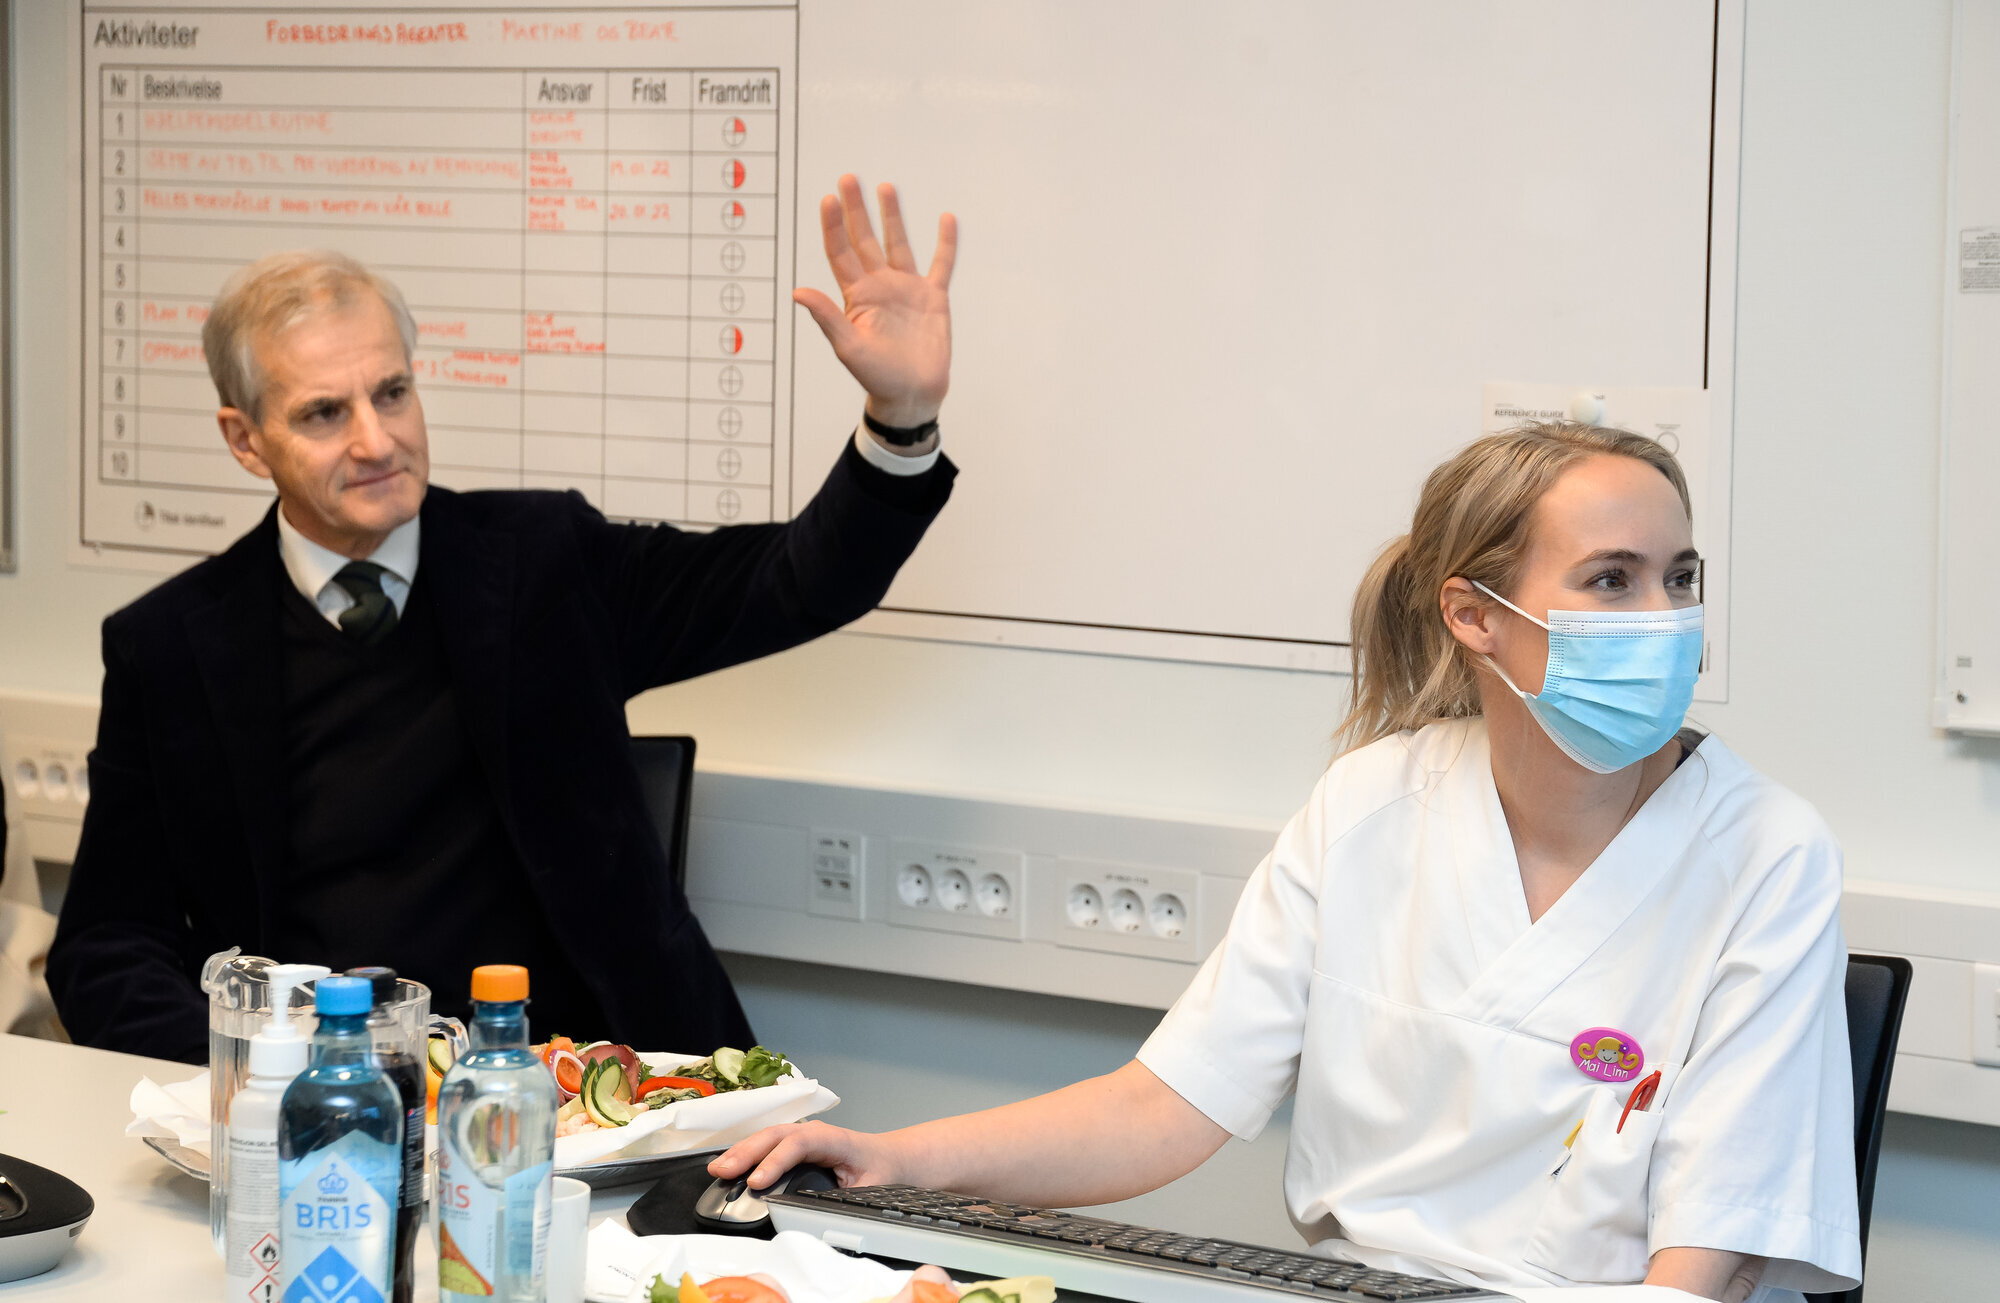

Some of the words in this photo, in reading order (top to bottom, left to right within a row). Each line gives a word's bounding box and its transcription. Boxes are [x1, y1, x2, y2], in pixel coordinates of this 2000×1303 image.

[93, 20, 199, 48] Aktiviteter
[110, 72, 128, 97] Nr
[144, 74, 222, 99] Beskrivelse
[537, 76, 592, 102] Ansvar
[632, 76, 667, 102] Frist
[699, 77, 771, 104] Framdrift
[117, 111, 124, 136] 1
[115, 149, 125, 175] 2
[115, 187, 126, 213] 3
[114, 226, 125, 248] 4
[115, 262, 126, 289] 5
[115, 338, 125, 361] 7
[1494, 408, 1537, 418] REFERENCE
[1540, 410, 1564, 419] GUIDE
[111, 450, 129, 477] 10
[1579, 1059, 1600, 1073] Mai
[1603, 1063, 1629, 1079] Linn
[296, 1203, 372, 1230] BRIS
